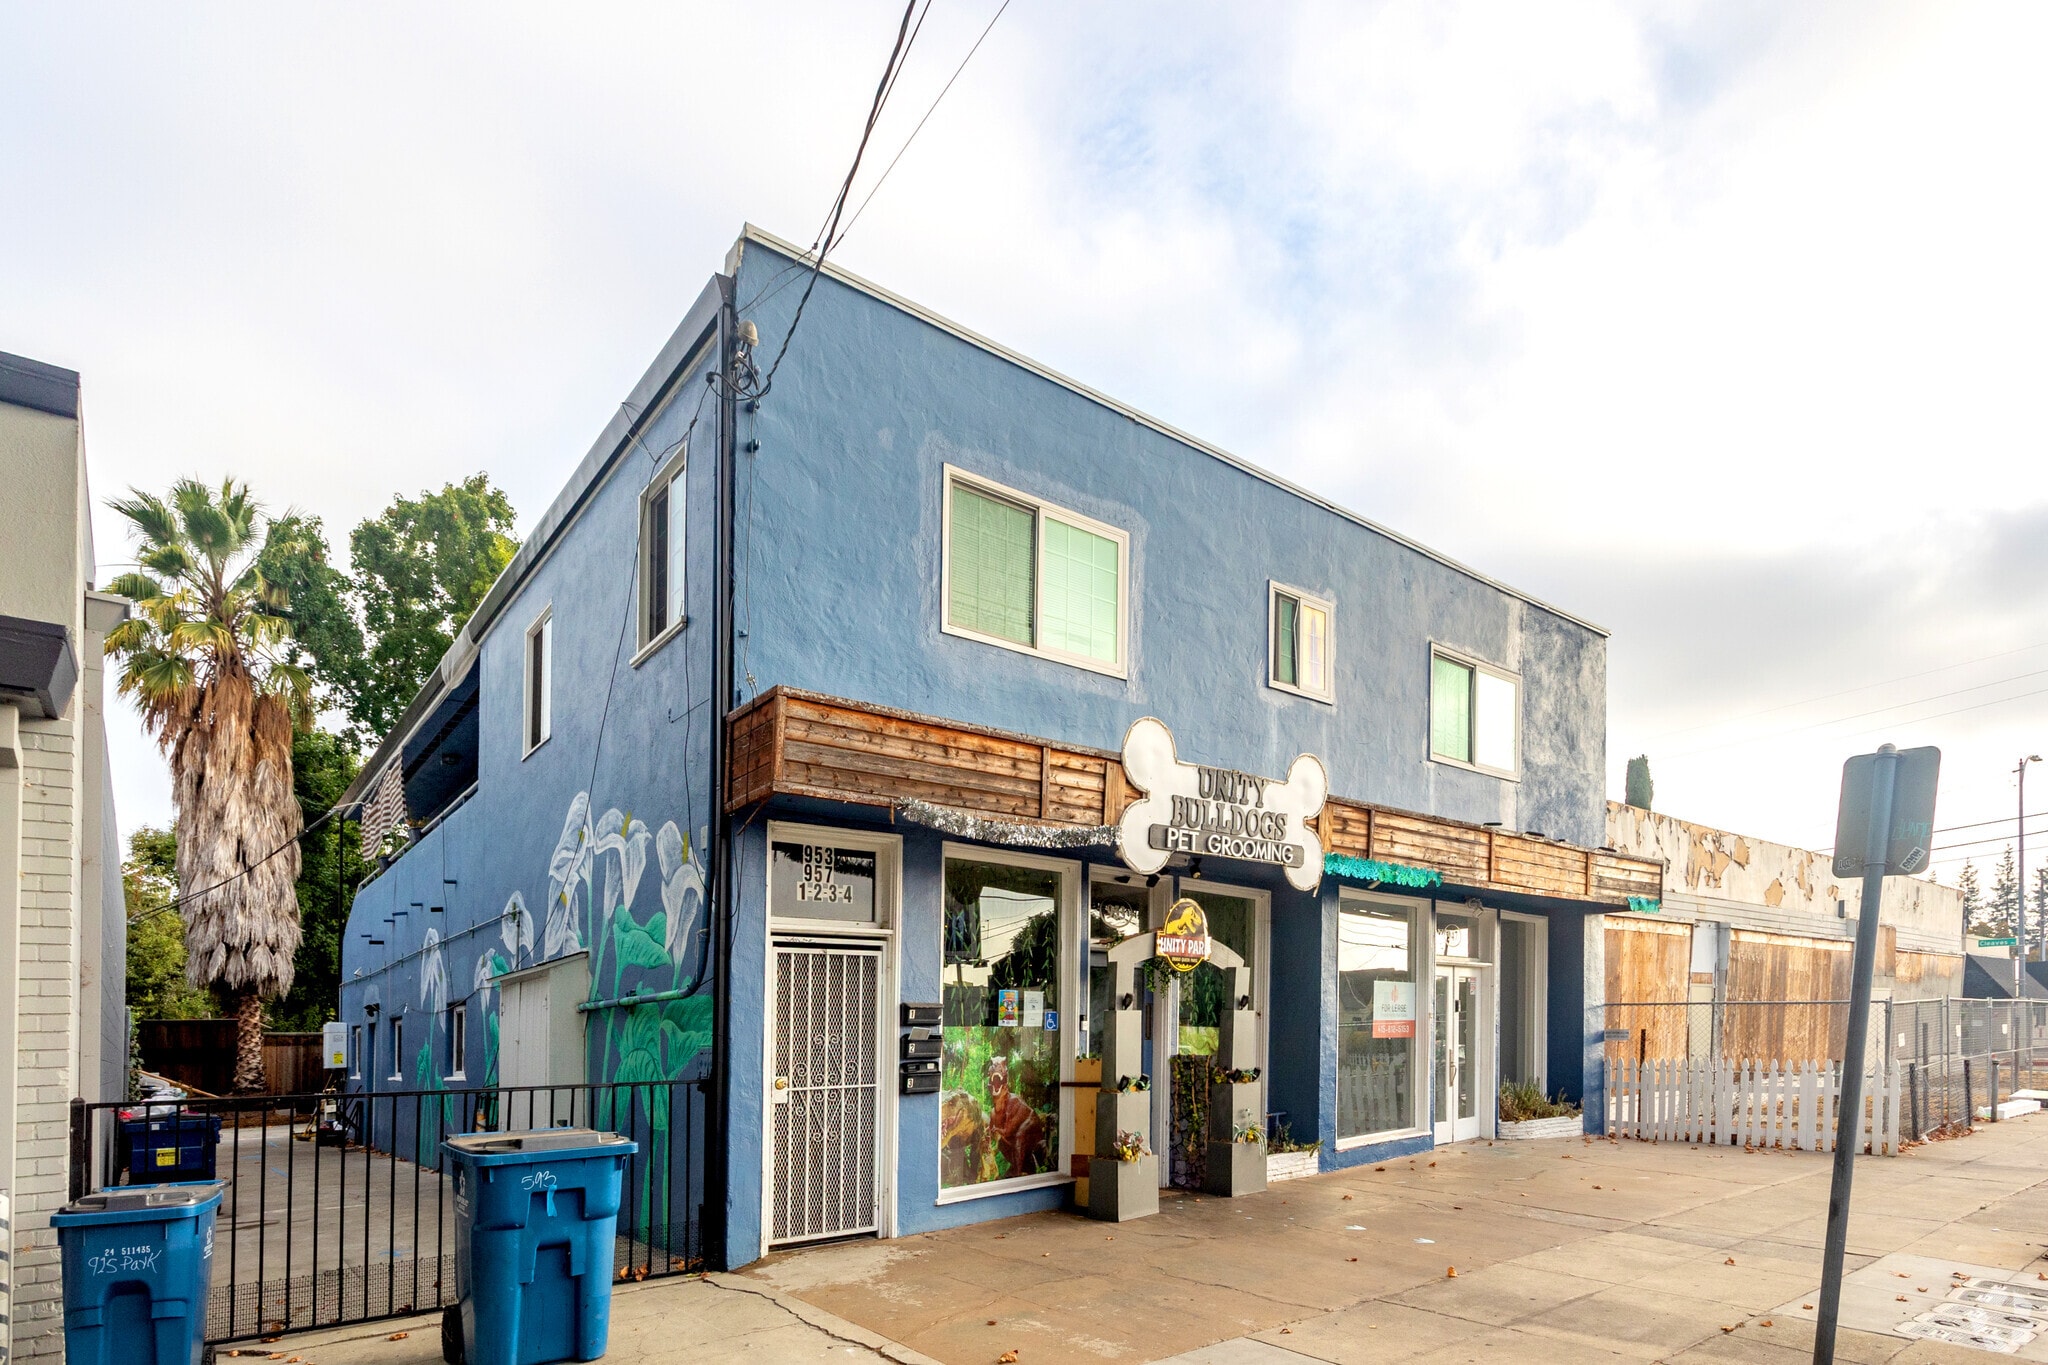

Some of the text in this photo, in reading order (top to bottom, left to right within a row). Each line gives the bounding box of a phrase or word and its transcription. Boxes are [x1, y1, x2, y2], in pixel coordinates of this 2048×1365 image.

[1198, 767, 1266, 808] UNITY
[1171, 794, 1287, 841] BULLDOGS
[1167, 827, 1294, 863] PET GROOMING
[804, 845, 832, 865] 953
[804, 864, 832, 884] 957
[1160, 936, 1211, 956] UNITY PAR
[911, 1010, 914, 1018] 1
[1382, 1004, 1407, 1012] FOR LEASE
[910, 1044, 914, 1052] 2
[909, 1079, 913, 1087] 3
[521, 1171, 557, 1190] 593
[104, 1246, 151, 1256] 24 511435
